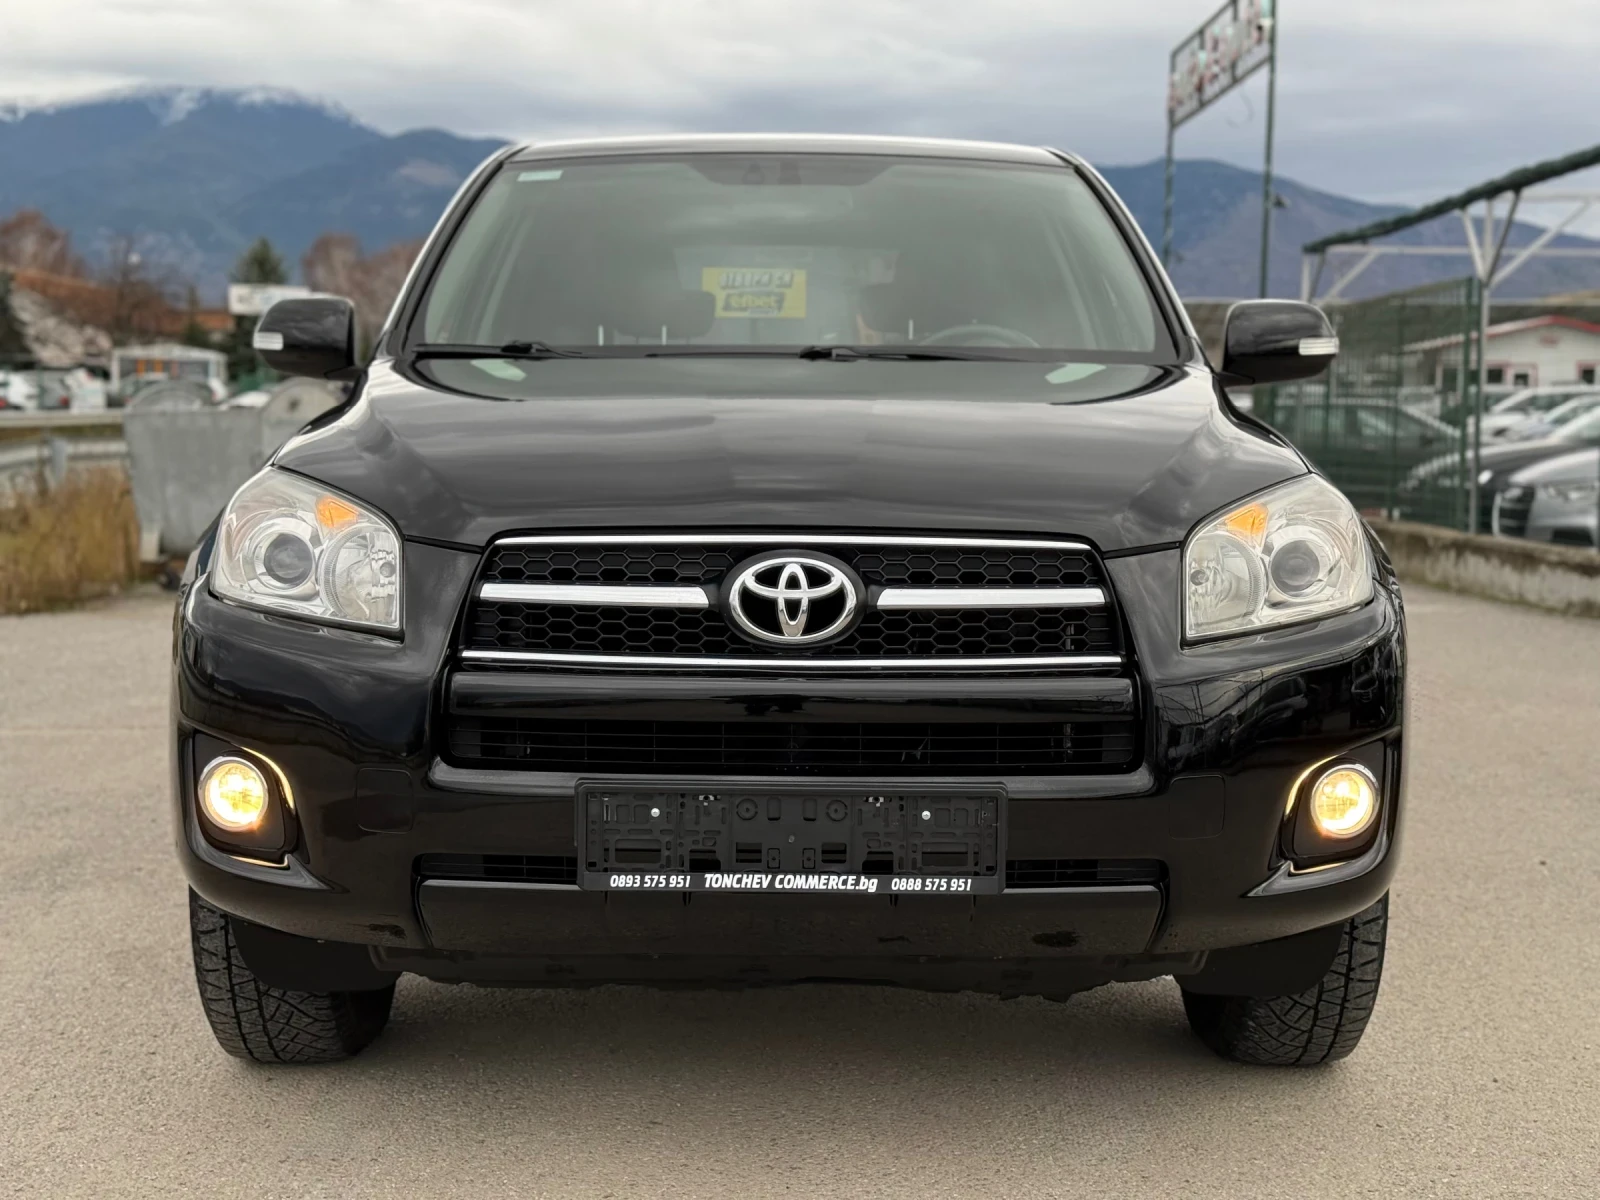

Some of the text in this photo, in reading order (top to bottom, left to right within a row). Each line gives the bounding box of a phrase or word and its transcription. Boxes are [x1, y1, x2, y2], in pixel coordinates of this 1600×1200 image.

[609, 873, 972, 893] 0893 575 951 TONCHEV COMMERCE.bg 0888 575 951
